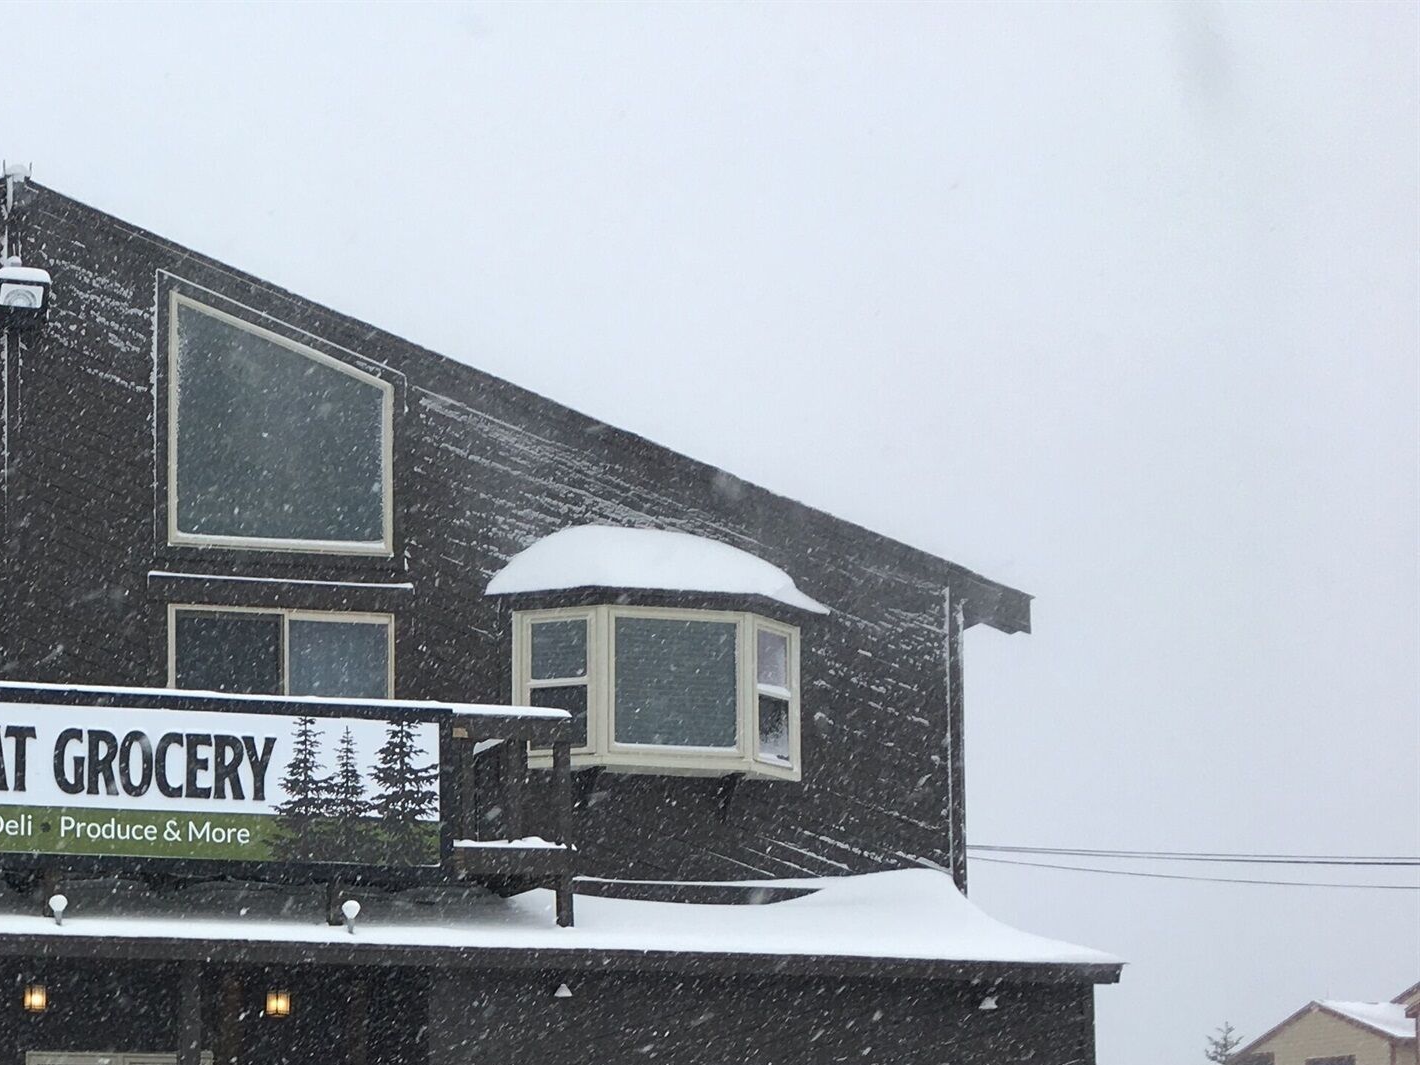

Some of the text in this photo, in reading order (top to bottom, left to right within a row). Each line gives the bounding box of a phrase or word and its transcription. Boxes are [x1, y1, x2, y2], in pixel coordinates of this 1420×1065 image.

[53, 727, 277, 801] GROCERY
[60, 816, 158, 842] Produce
[163, 820, 184, 843] &
[188, 821, 251, 845] More
